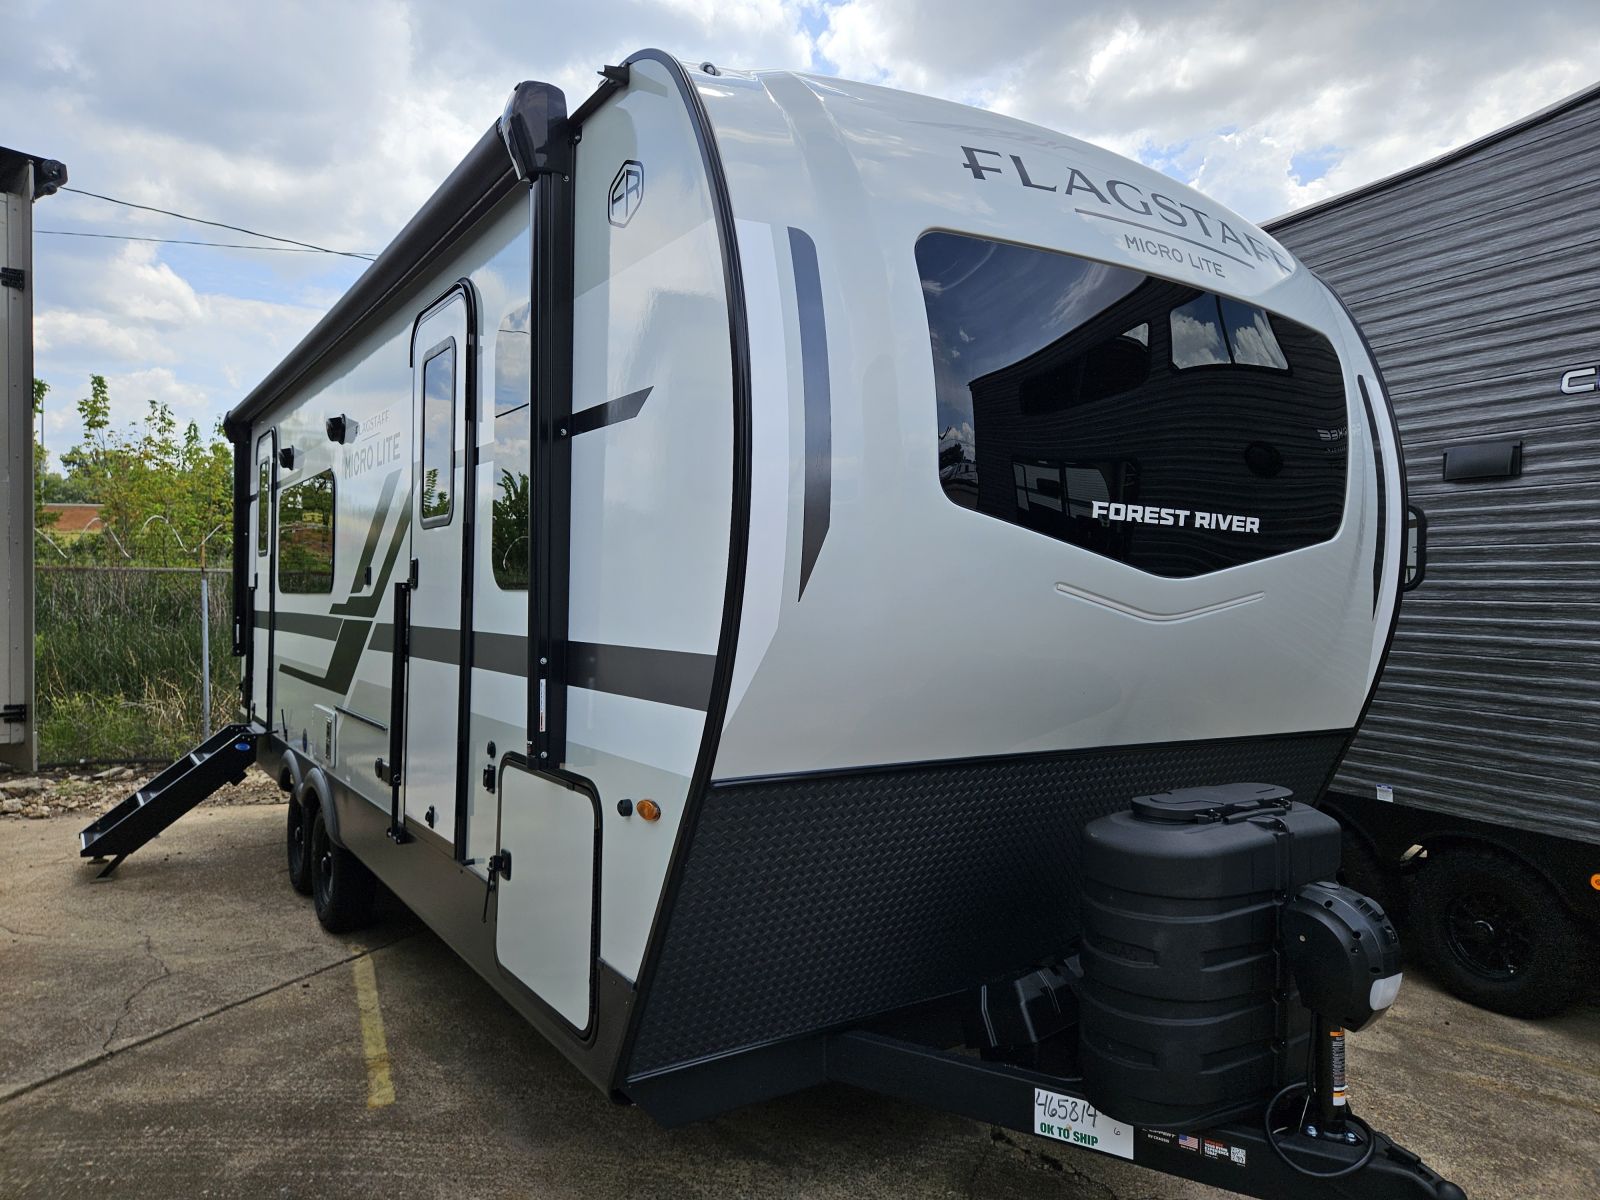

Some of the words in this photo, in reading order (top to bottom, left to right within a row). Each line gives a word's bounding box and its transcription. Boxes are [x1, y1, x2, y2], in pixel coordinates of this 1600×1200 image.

[961, 145, 1292, 273] FLAGSTAFF
[1124, 234, 1184, 263] MICRO
[1188, 254, 1226, 278] LITE
[1561, 366, 1600, 395] C
[344, 445, 373, 479] MICRO
[376, 432, 401, 467] LITE
[1092, 500, 1190, 527] FOREST
[1194, 511, 1260, 534] RIVER
[1036, 1091, 1098, 1128] 465814
[1040, 1122, 1055, 1136] OK
[1057, 1126, 1070, 1140] TO
[1073, 1131, 1099, 1147] SHIP
